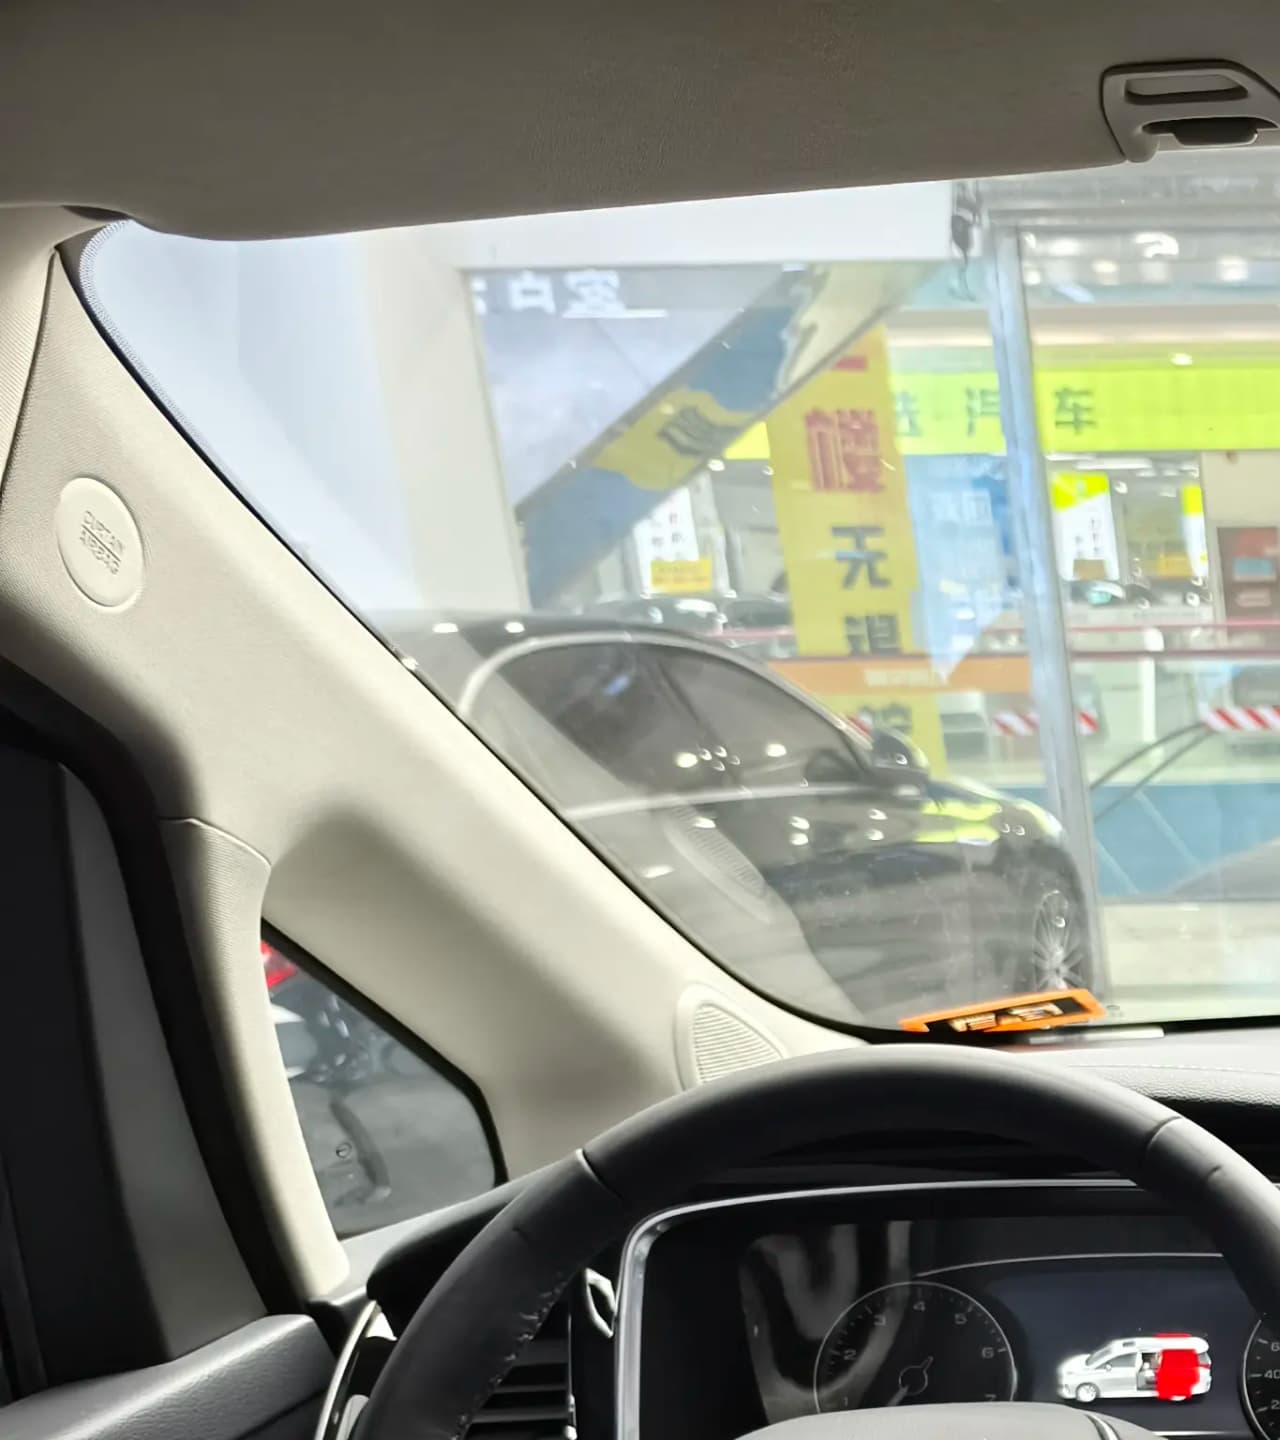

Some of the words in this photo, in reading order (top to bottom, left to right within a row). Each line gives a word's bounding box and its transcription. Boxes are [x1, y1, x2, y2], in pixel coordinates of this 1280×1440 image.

[912, 1300, 927, 1313] 4
[873, 1313, 887, 1327] 3
[954, 1313, 968, 1326] 5
[842, 1349, 857, 1361] 2
[980, 1346, 995, 1360] 6
